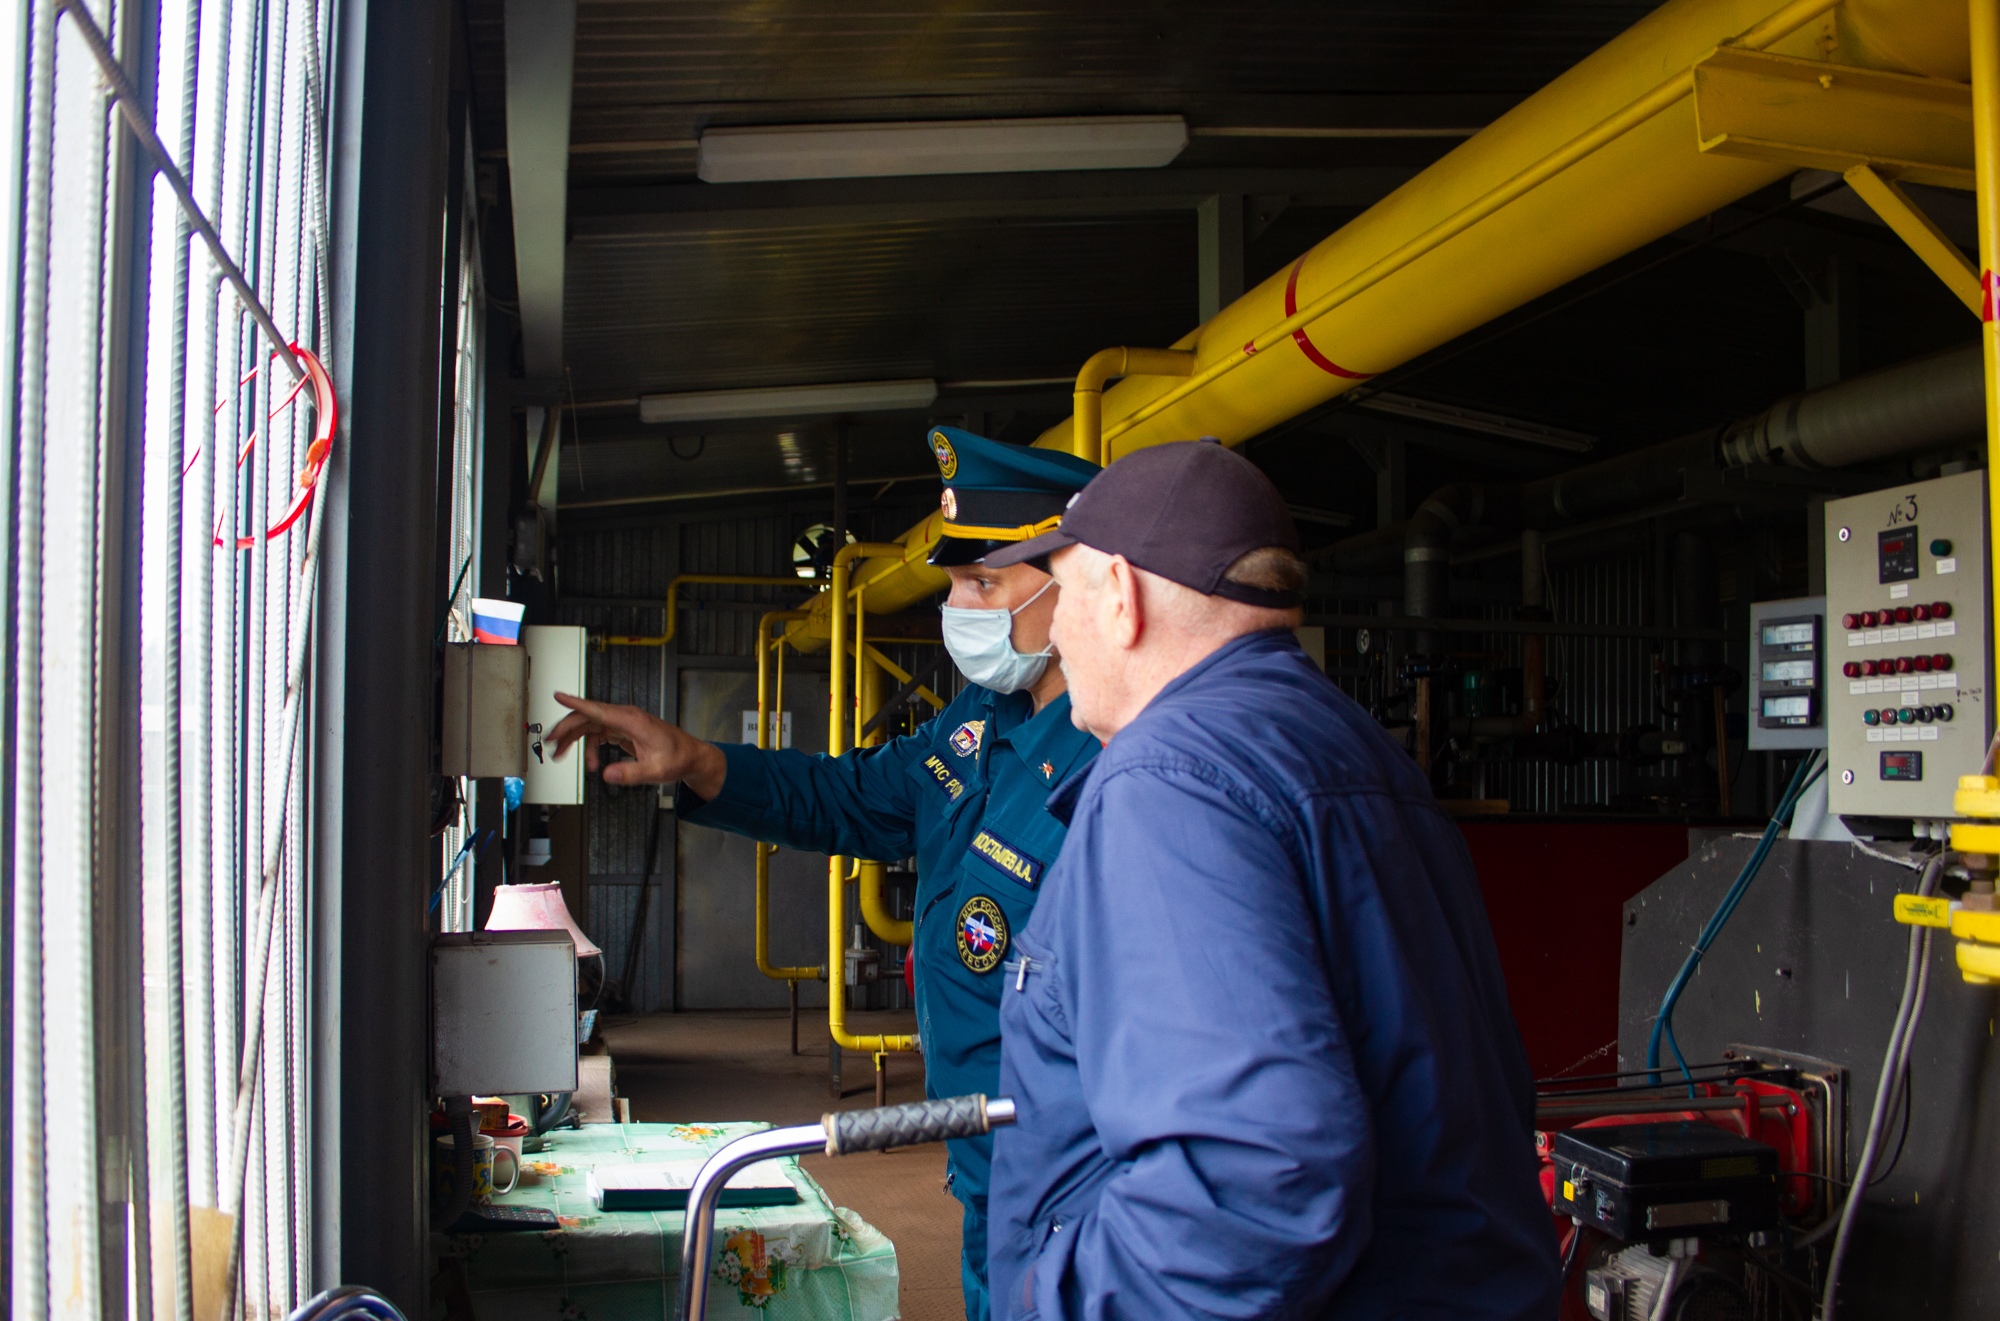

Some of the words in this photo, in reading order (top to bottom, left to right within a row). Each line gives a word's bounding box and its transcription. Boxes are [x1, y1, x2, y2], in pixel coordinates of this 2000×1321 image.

[925, 755, 950, 781] МЧС
[961, 901, 977, 919] МЧС
[980, 901, 1003, 940] РОССИИ
[958, 931, 997, 968] EMERCOM
